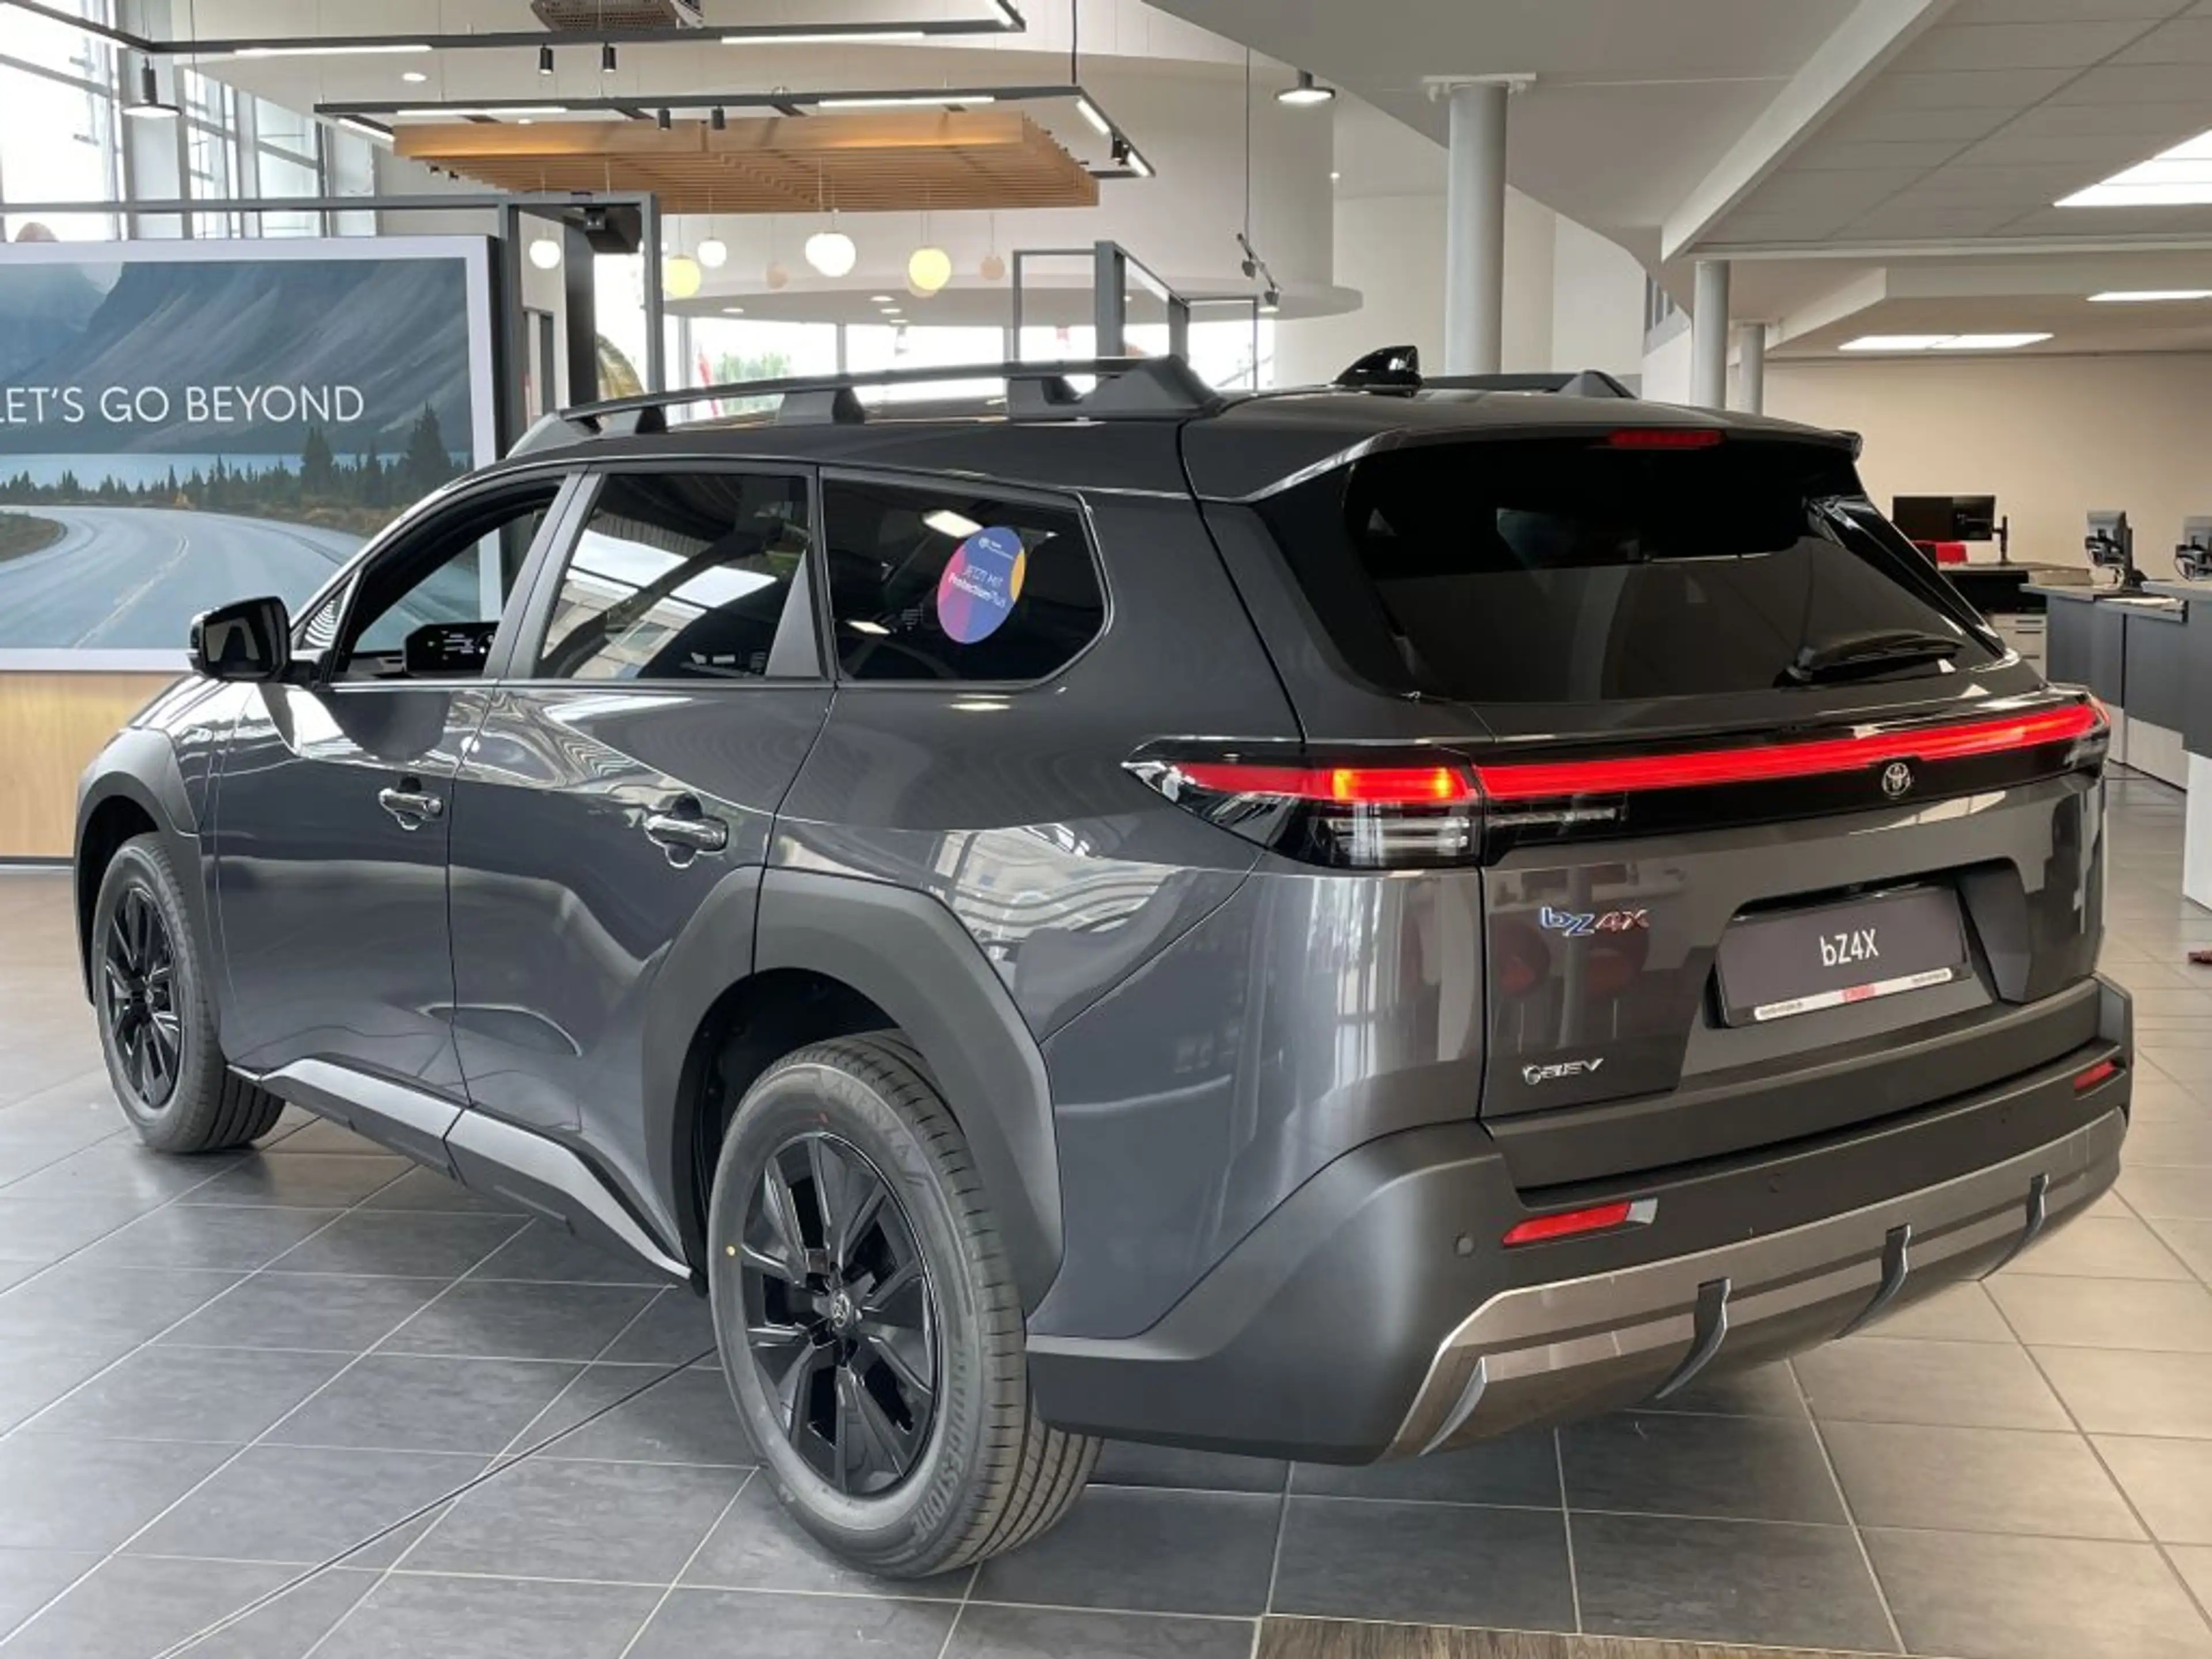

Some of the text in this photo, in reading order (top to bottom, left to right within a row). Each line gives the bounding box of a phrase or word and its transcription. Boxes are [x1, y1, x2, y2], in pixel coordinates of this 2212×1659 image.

[0, 385, 364, 422] ET'S GO BEYOND
[1819, 929, 1879, 966] bZ4X
